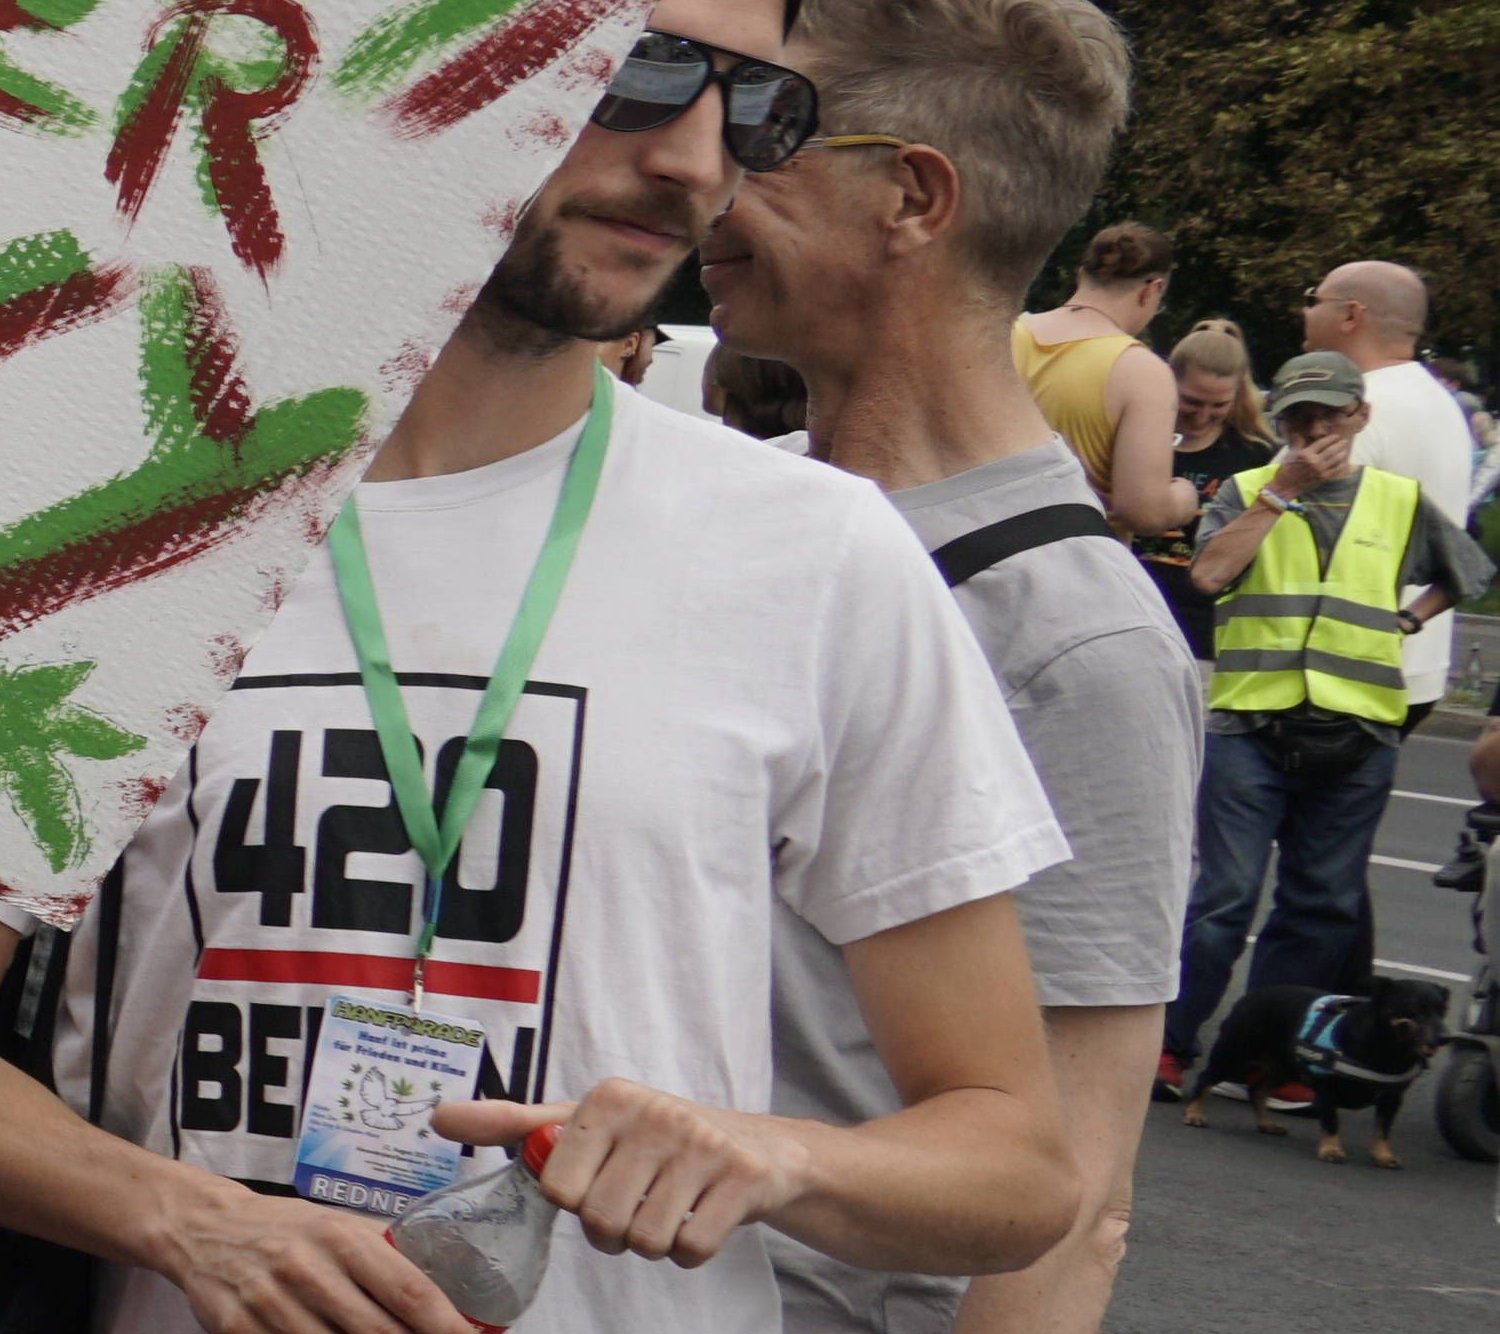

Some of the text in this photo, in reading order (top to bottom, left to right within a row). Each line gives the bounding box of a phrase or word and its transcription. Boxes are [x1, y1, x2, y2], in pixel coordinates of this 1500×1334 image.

[213, 728, 539, 944] 420
[333, 1040, 467, 1078] für Frieden und Klima
[358, 1030, 388, 1045] Hanf
[411, 1045, 448, 1058] prima
[311, 1174, 422, 1216] REDNE
